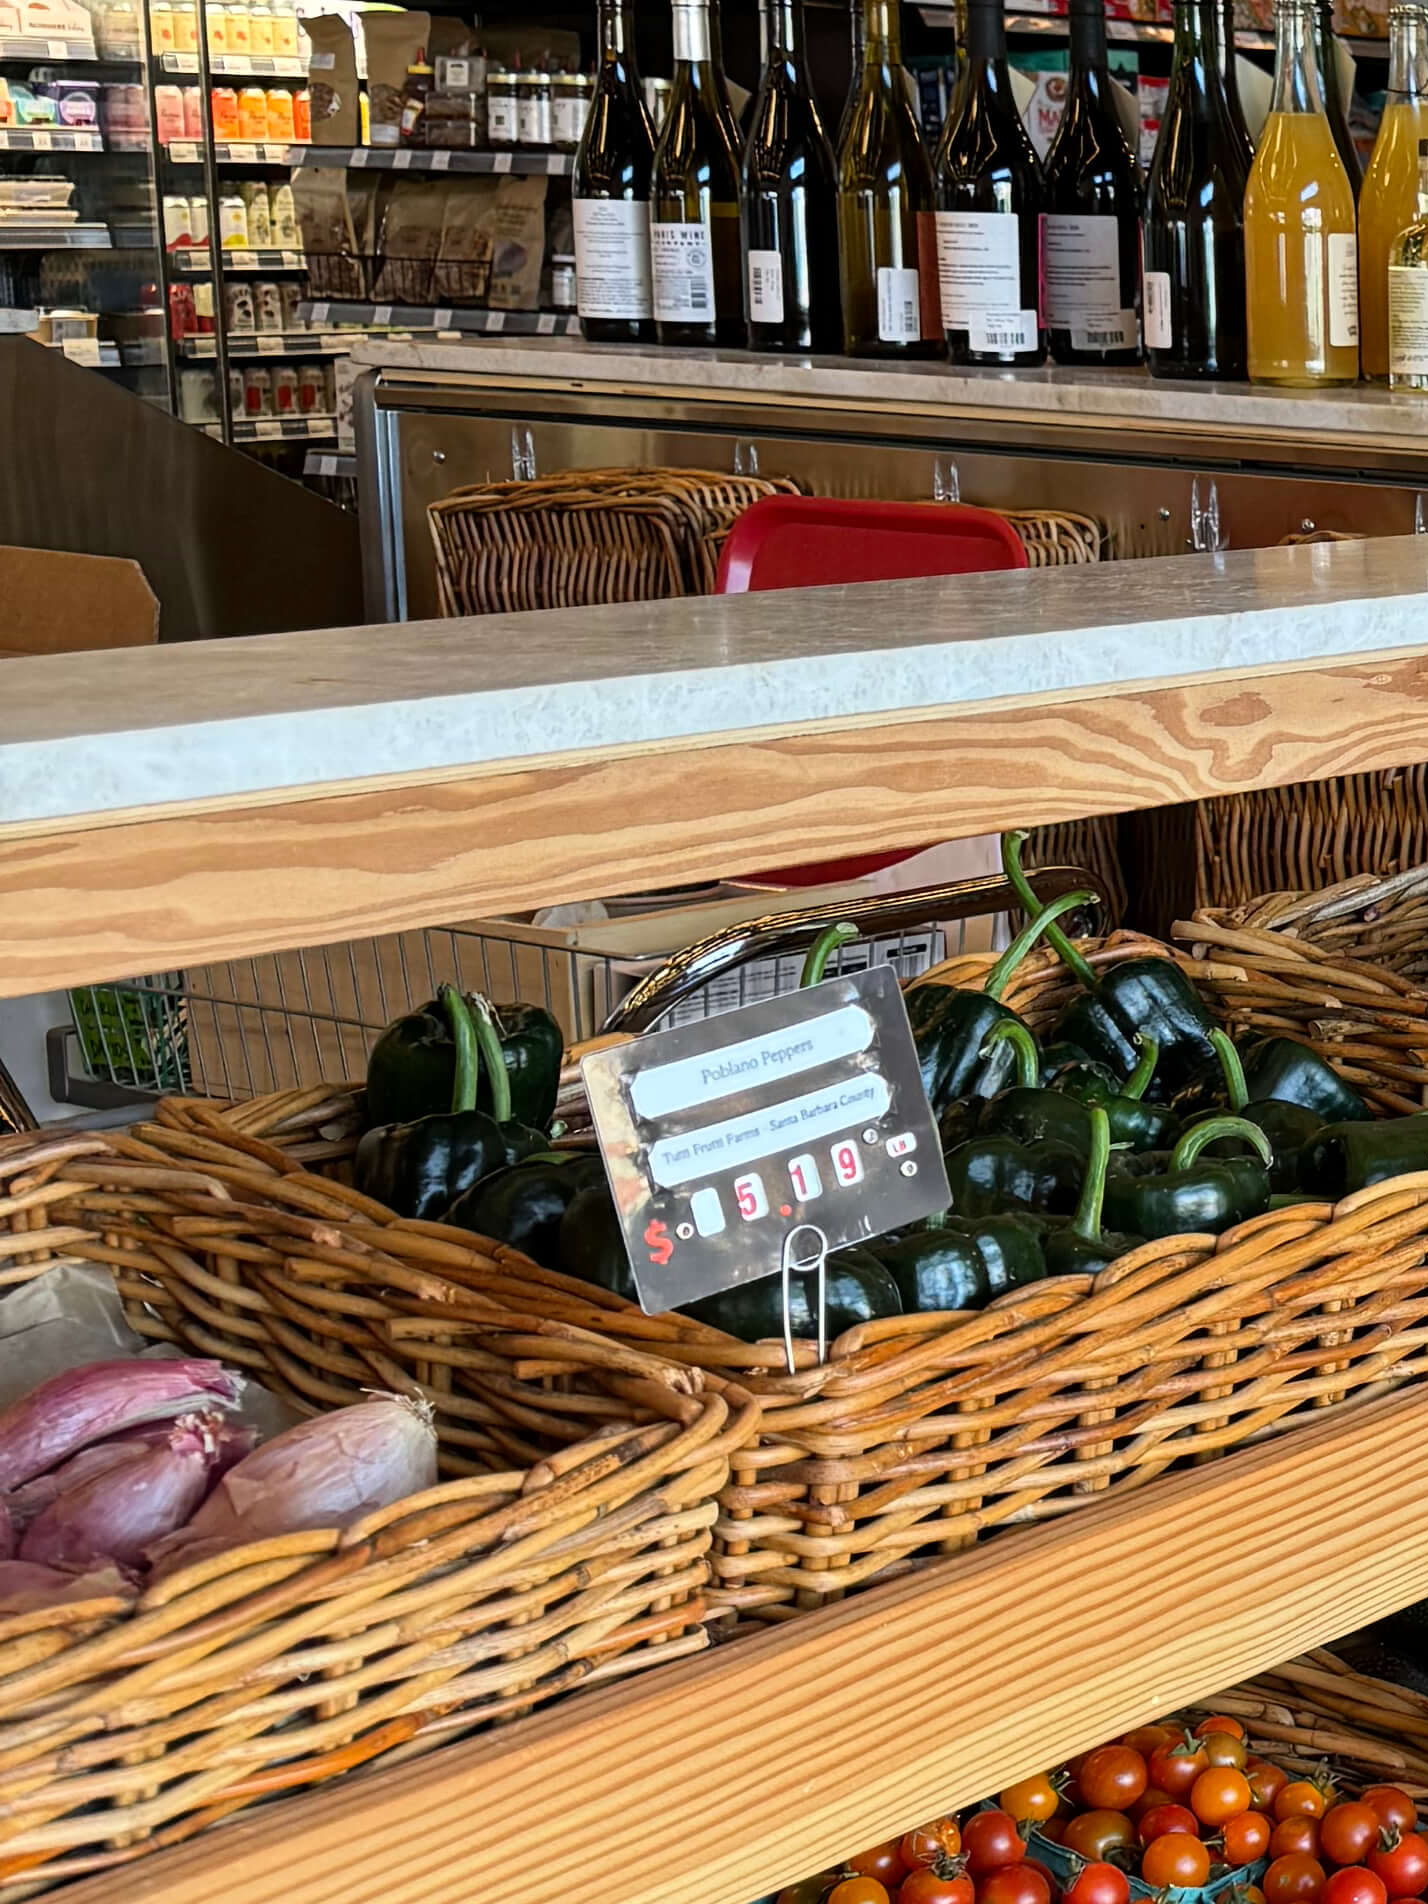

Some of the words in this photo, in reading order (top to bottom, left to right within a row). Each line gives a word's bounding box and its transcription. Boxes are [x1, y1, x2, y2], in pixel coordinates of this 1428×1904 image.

[699, 1051, 760, 1086] Poblano
[760, 1036, 815, 1069] Peppers
[799, 1099, 840, 1126] Barbara
[838, 1084, 876, 1116] County
